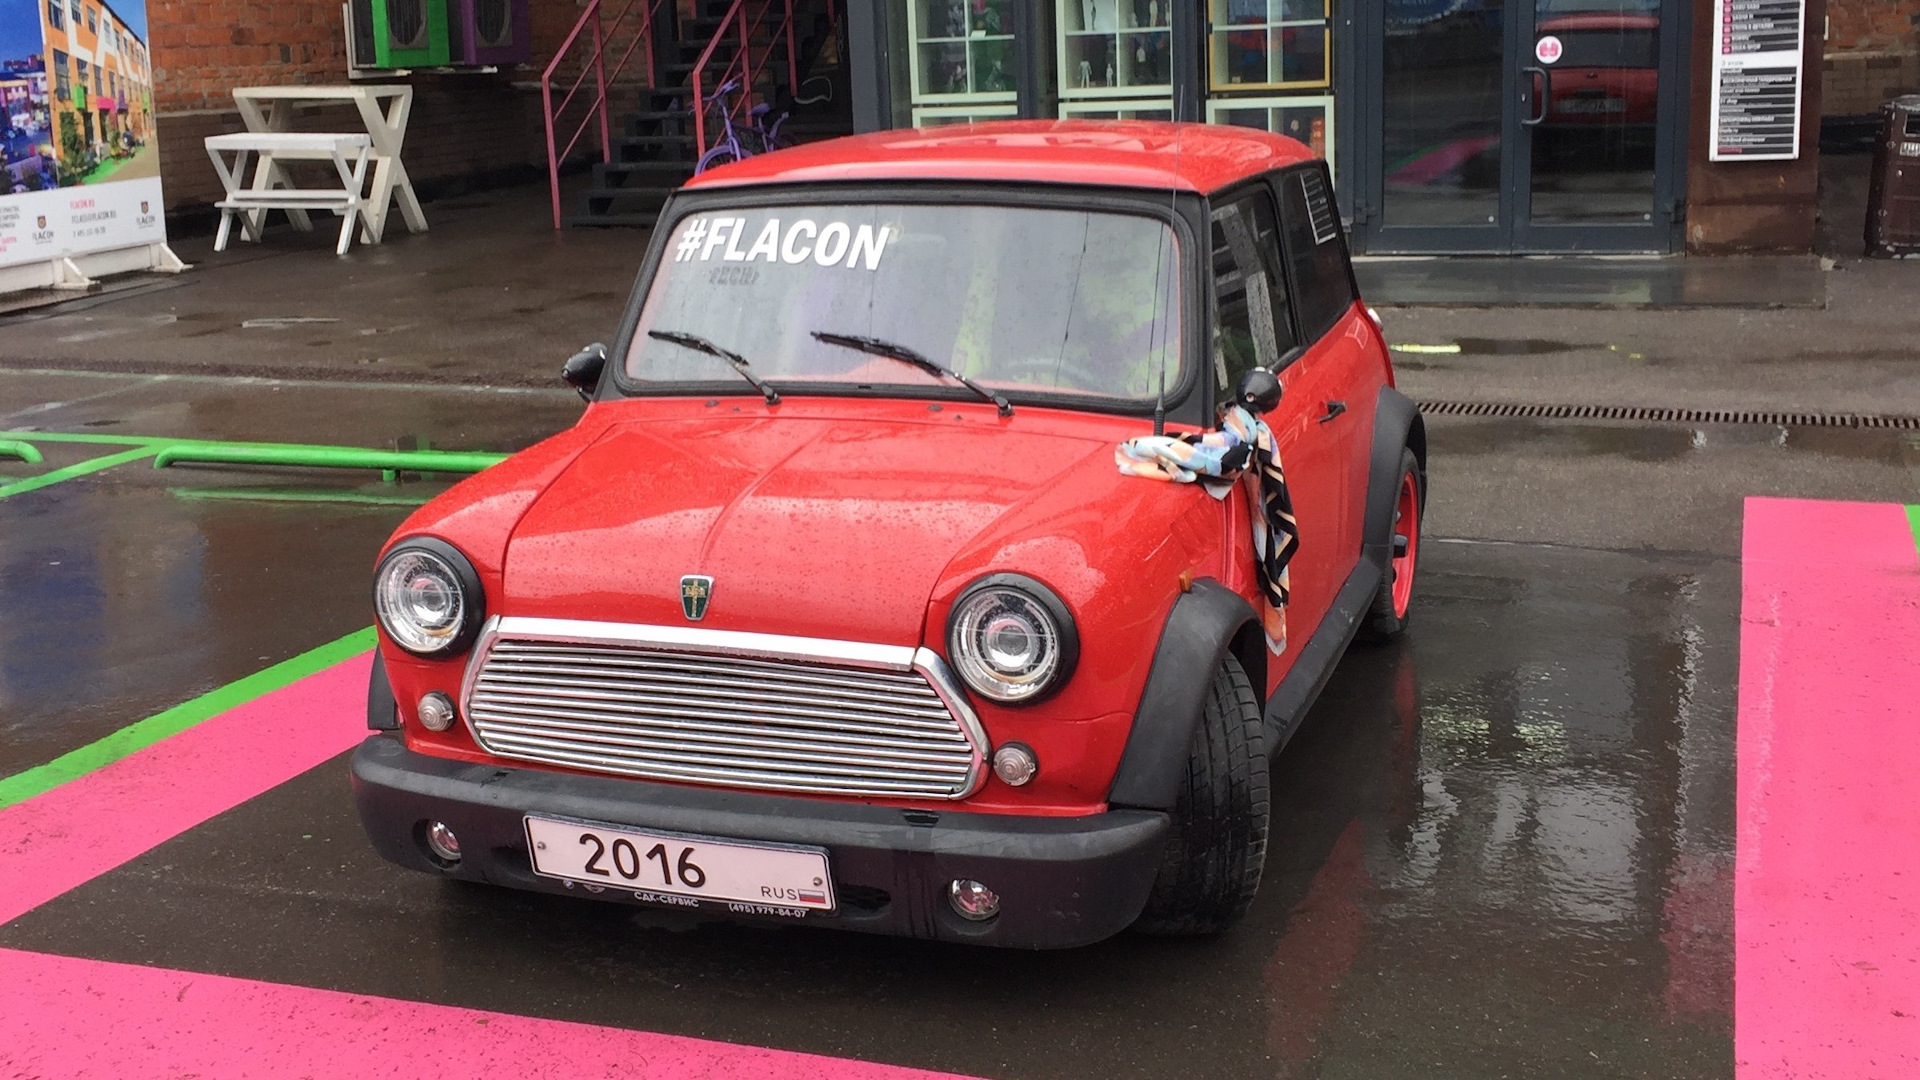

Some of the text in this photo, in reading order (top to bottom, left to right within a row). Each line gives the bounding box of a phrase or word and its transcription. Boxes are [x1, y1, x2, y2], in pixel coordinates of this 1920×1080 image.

[675, 217, 890, 271] #FLACON
[579, 833, 706, 888] 2016
[728, 902, 756, 915] (495)
[760, 885, 798, 901] RUS
